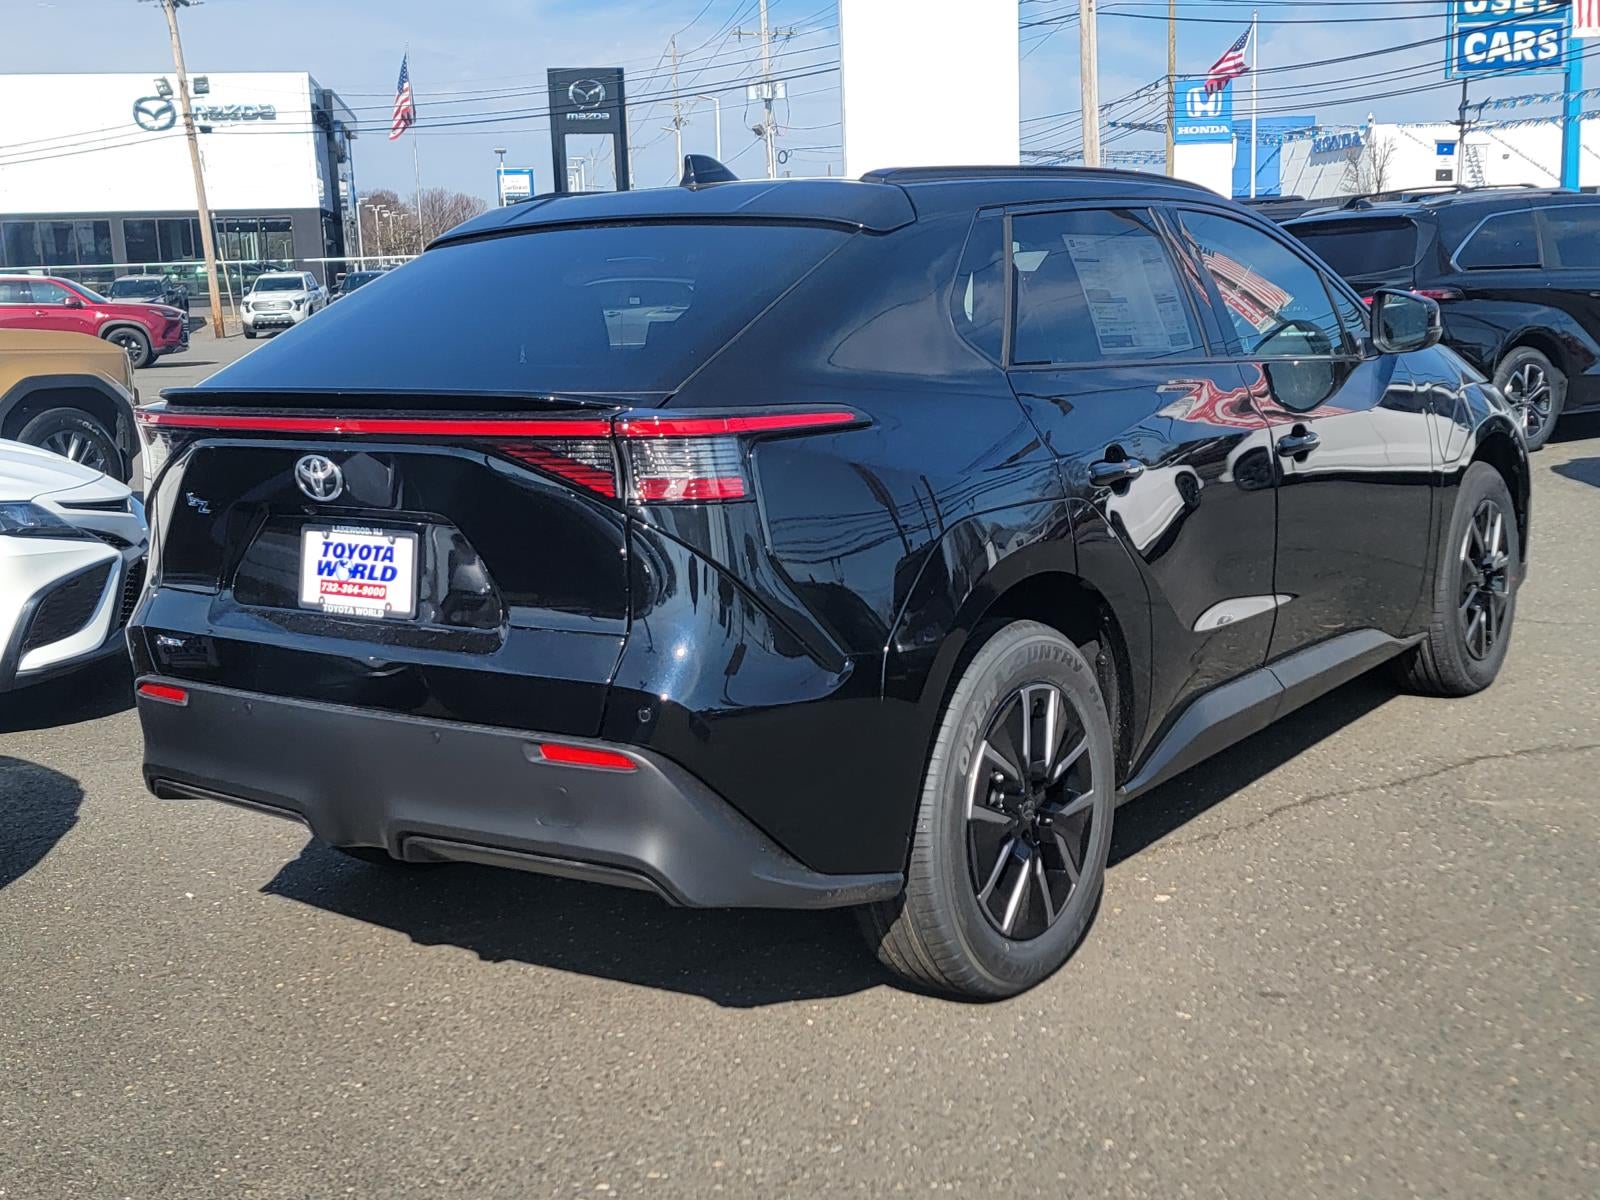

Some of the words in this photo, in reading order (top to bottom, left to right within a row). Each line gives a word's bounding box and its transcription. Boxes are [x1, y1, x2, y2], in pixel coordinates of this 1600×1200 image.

[1463, 28, 1559, 64] CARS
[1177, 125, 1230, 135] HONDA
[1311, 131, 1362, 153] HONDA
[322, 541, 395, 563] TOYOTA
[323, 604, 354, 615] TOYOTA
[355, 606, 384, 618] WORLD
